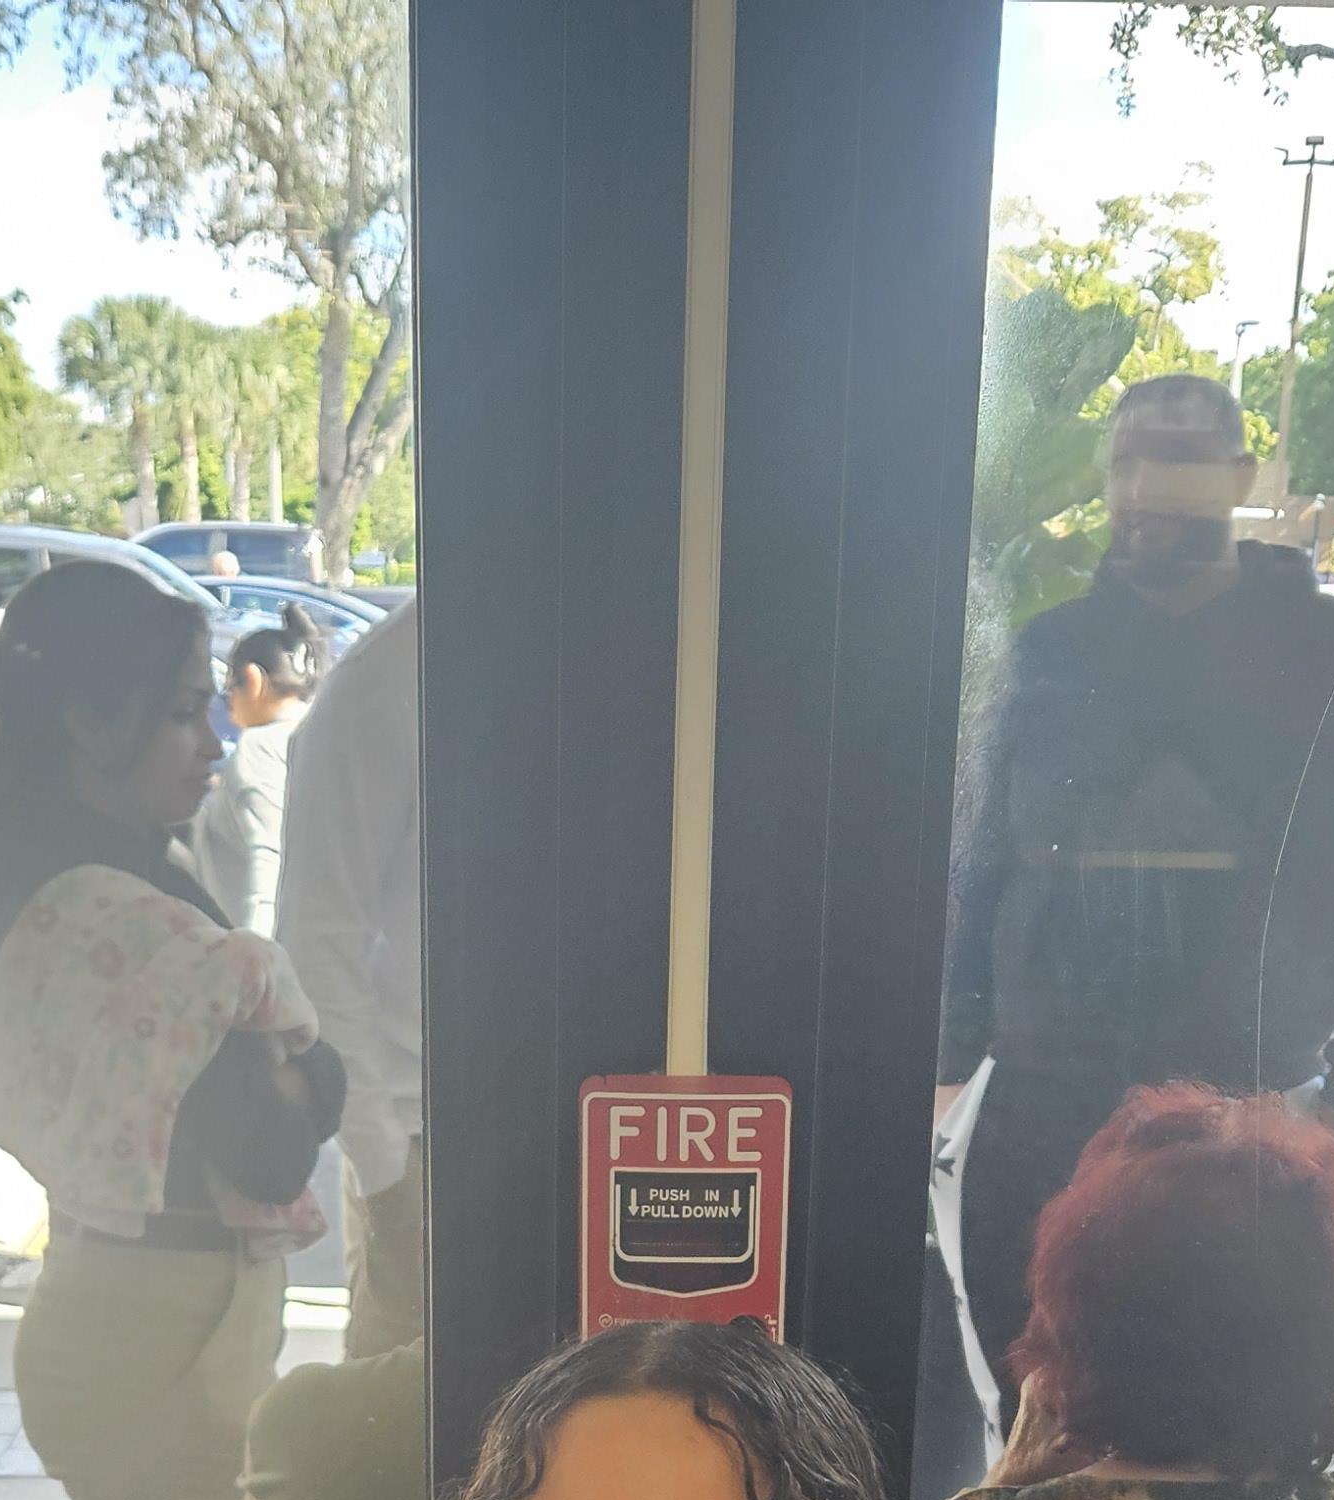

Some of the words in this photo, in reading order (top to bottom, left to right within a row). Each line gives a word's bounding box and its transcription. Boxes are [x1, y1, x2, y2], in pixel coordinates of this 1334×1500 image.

[609, 1105, 763, 1162] FIRE
[649, 1188, 690, 1201] PUSH
[704, 1189, 720, 1202] IN
[640, 1205, 680, 1218] PULL
[682, 1205, 729, 1218] DOWN
